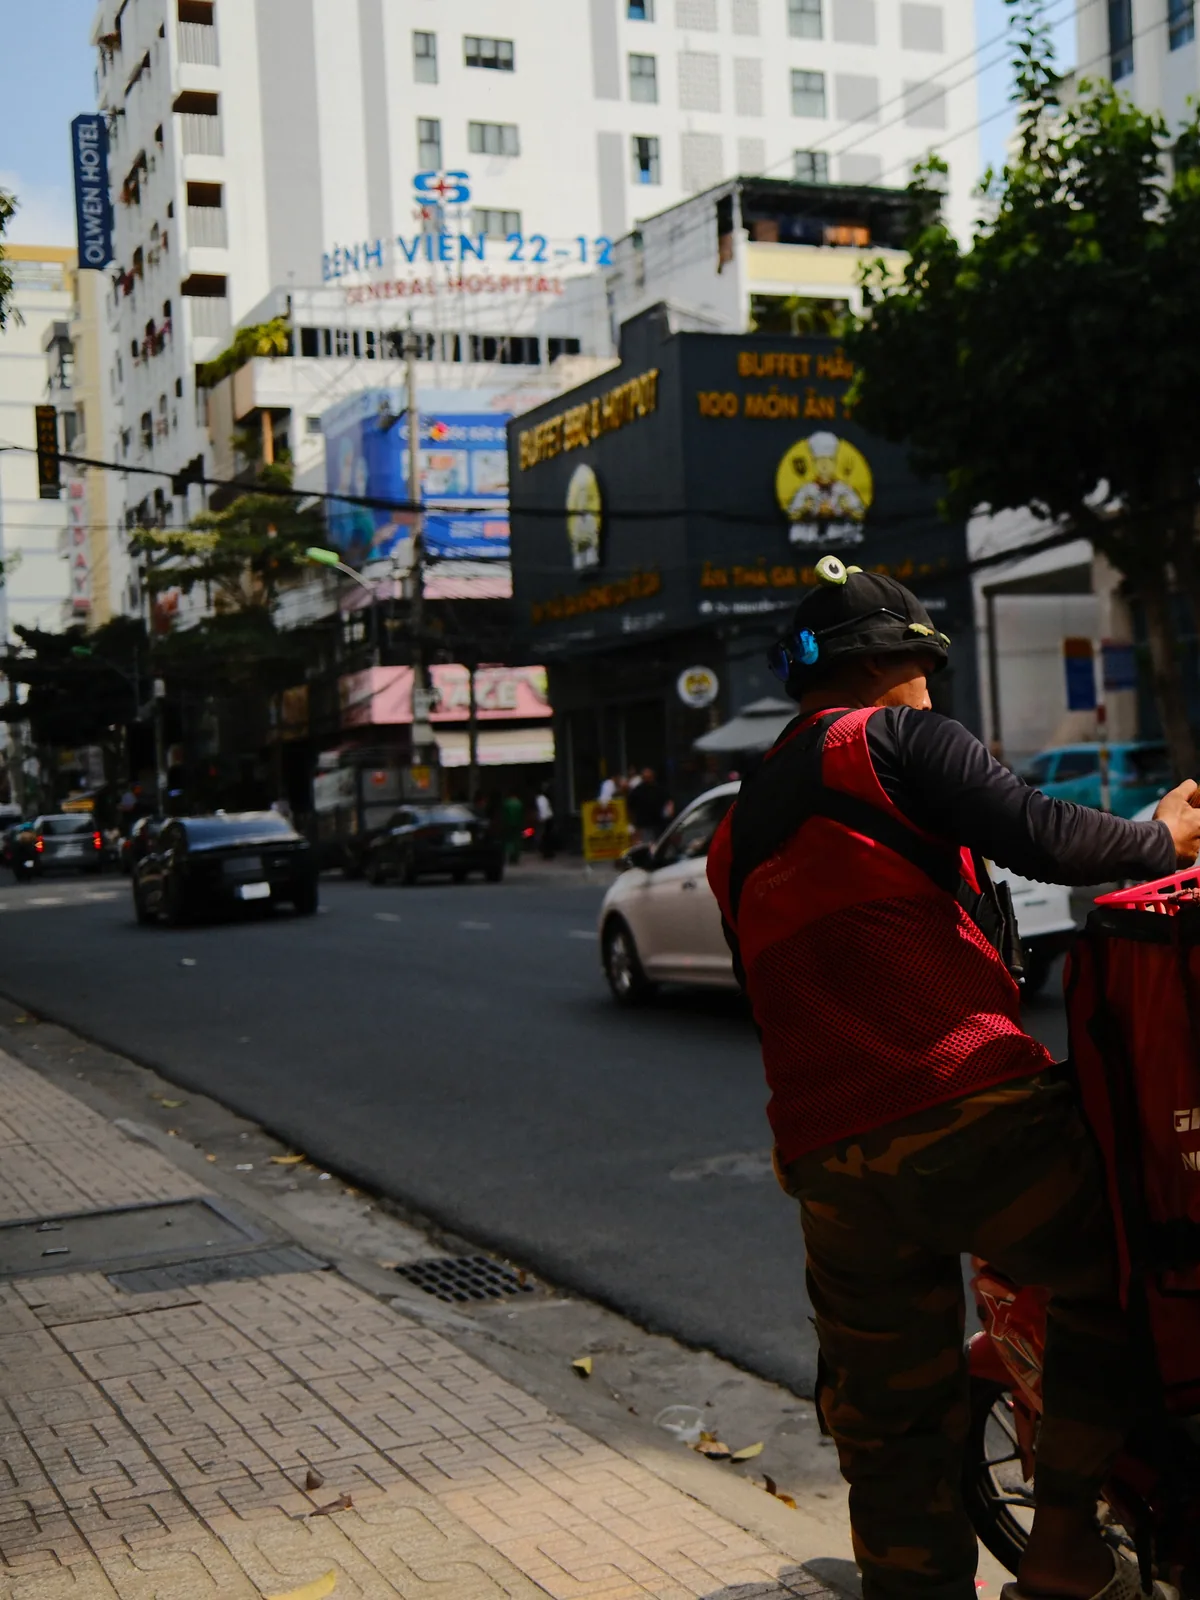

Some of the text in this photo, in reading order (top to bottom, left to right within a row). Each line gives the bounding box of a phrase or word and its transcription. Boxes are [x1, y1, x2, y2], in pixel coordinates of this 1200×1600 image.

[77, 120, 106, 264] OLWEN HOTEL
[505, 232, 614, 266] 22-12
[345, 275, 565, 305] GENERAL HOSPITAL
[737, 351, 811, 381] BUFFET
[696, 391, 739, 418] 100
[744, 384, 799, 420] MÓN
[802, 386, 837, 421] ĂN
